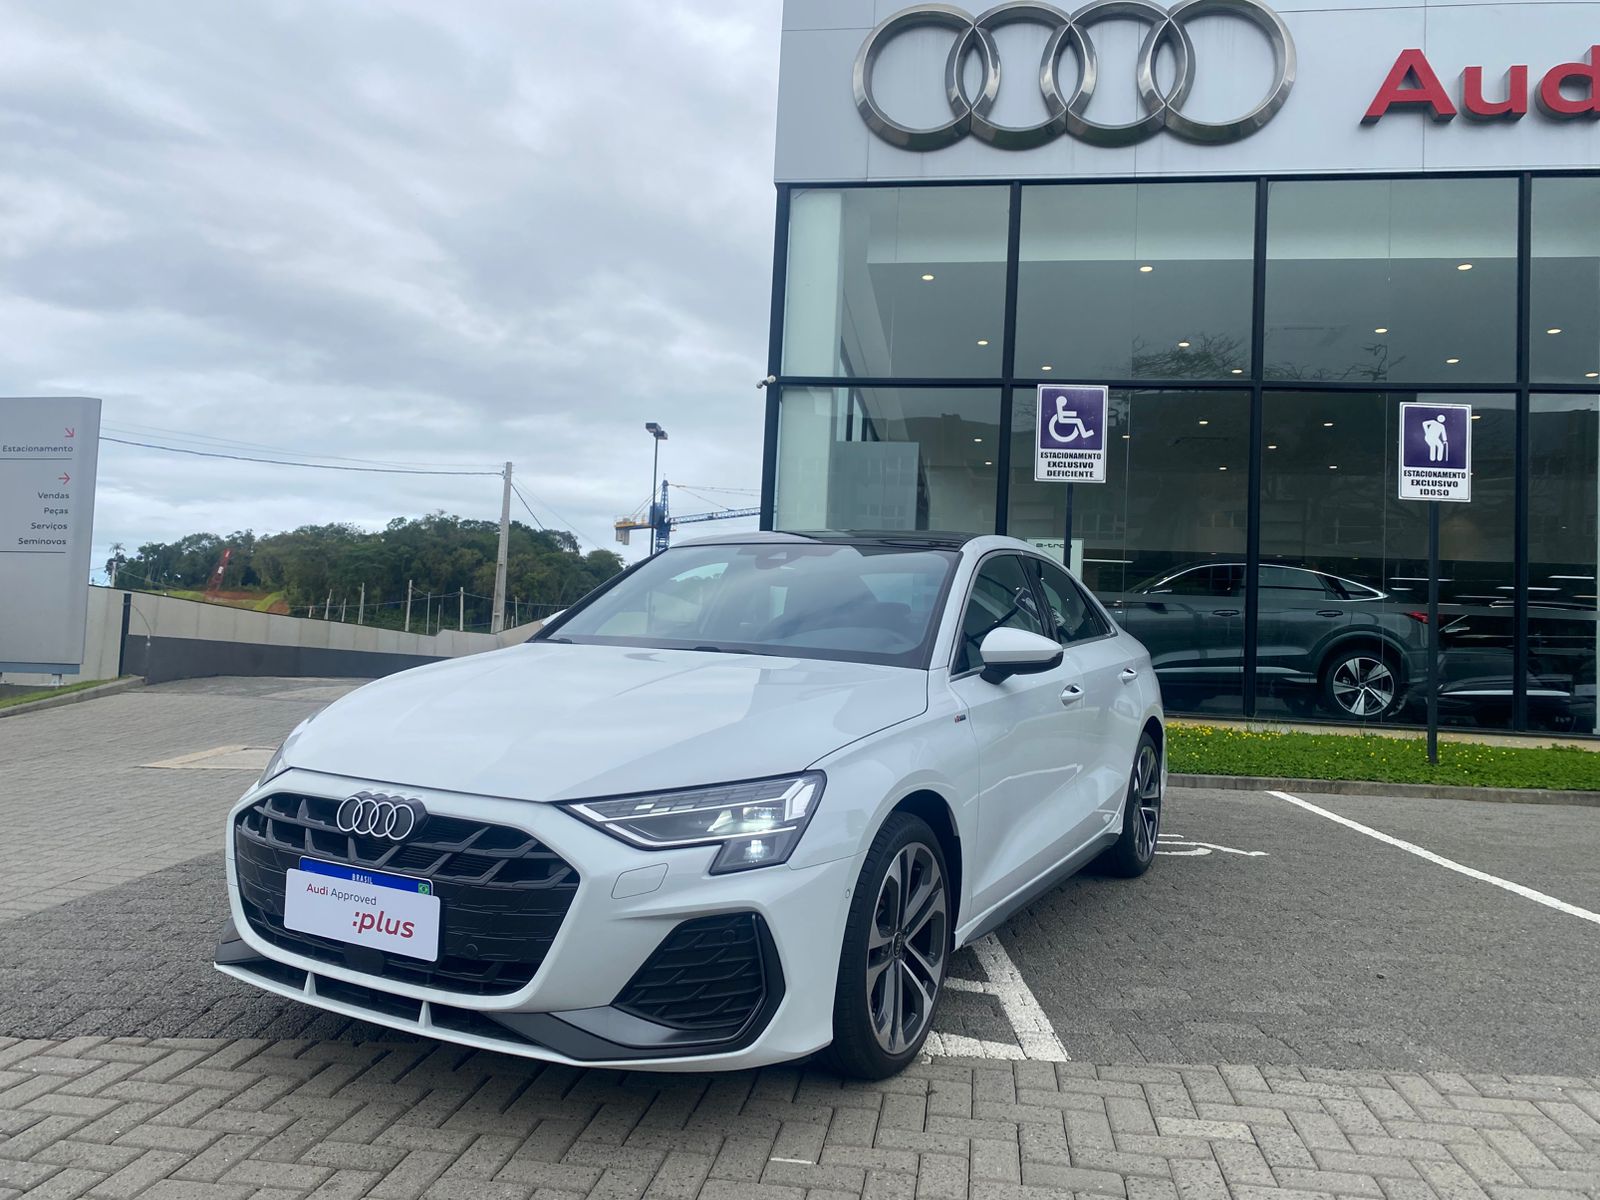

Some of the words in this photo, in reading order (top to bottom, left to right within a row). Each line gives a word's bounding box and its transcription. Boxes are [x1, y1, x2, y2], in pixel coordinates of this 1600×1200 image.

[1360, 45, 1600, 124] Aud
[2, 445, 74, 453] Estacionamento
[1040, 452, 1102, 460] ESTACIONAMENTO
[1047, 461, 1094, 469] EXCLUSIVO
[1047, 470, 1095, 478] DEFICIENTE
[1403, 470, 1466, 479] ESTACIONAMENTO
[1411, 479, 1459, 488] EXCLUSIVO
[38, 492, 70, 500] Vendas
[1420, 488, 1449, 496] IDOSO
[44, 507, 69, 517] Peças
[31, 522, 68, 531] Serviços
[18, 537, 67, 546] Seminovos
[351, 873, 374, 885] BRASIL
[306, 883, 329, 896] Audi
[331, 888, 377, 906] Approved
